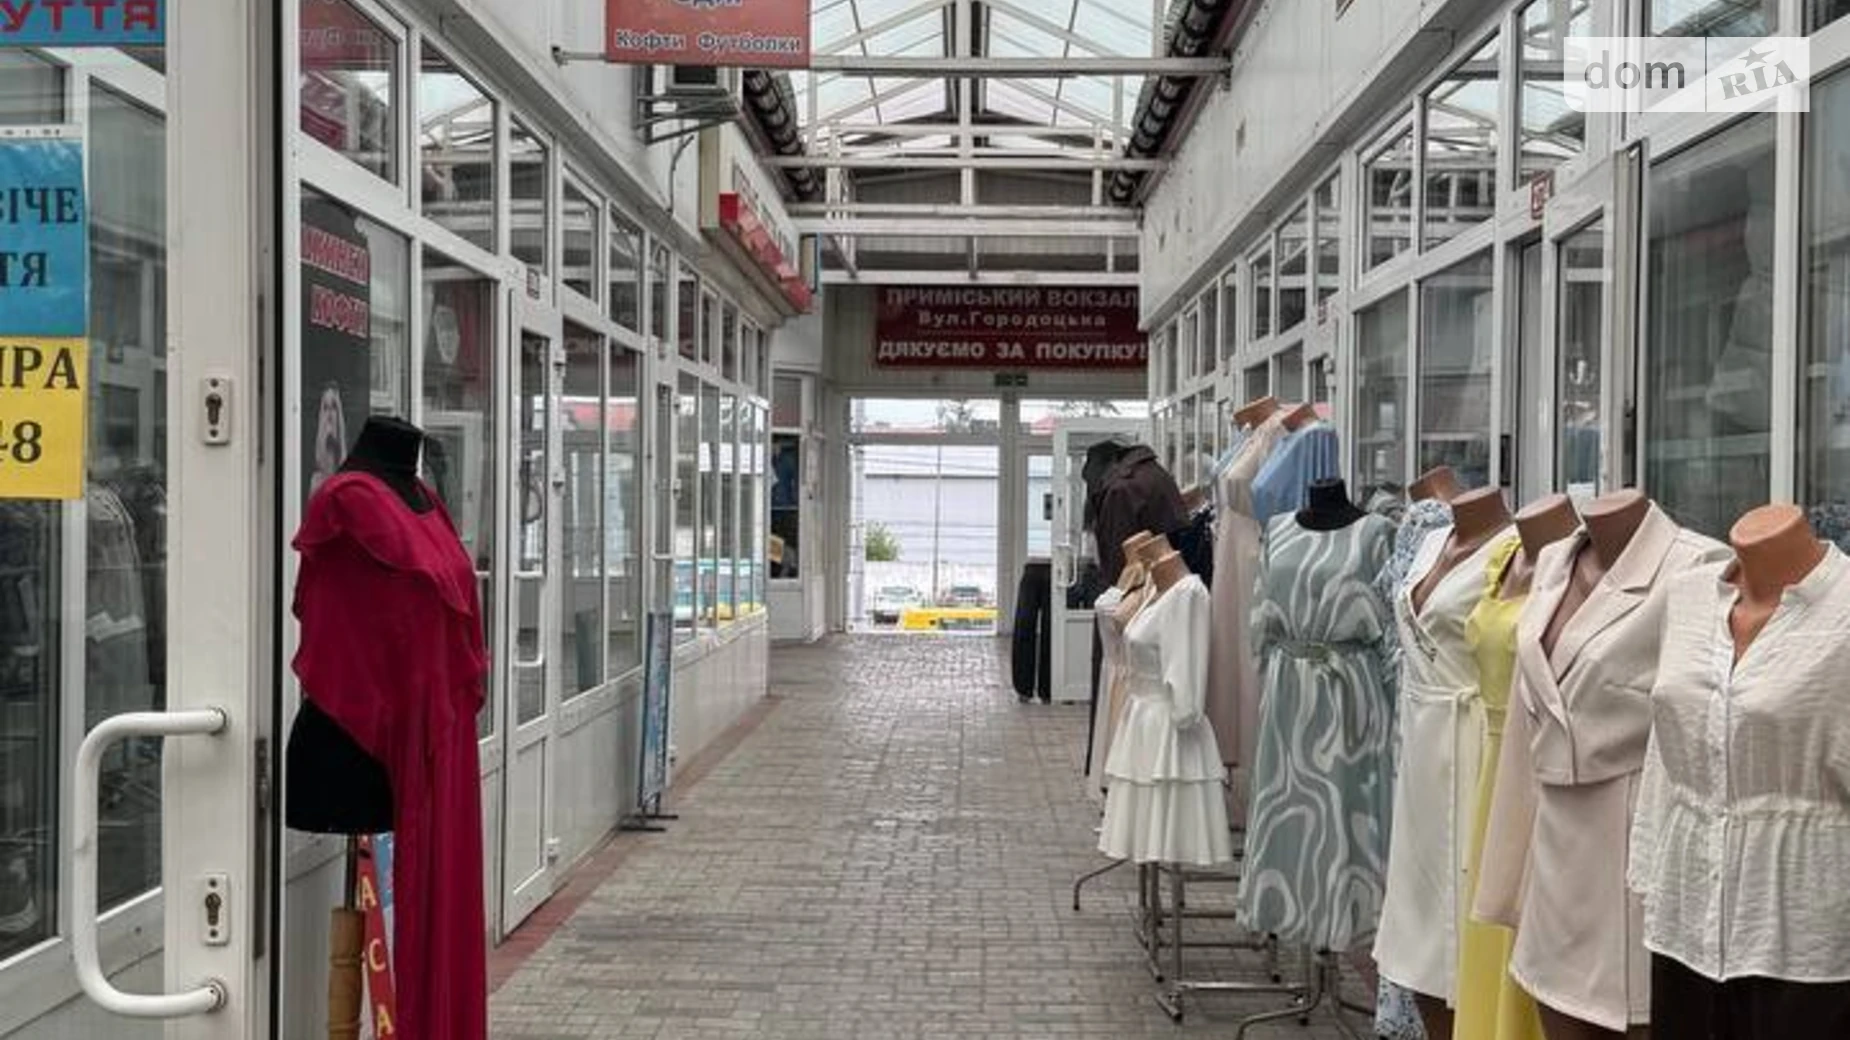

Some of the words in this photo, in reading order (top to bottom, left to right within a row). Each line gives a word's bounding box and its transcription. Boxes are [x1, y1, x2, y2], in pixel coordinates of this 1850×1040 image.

[616, 29, 686, 51] Кофти
[698, 31, 800, 54] Футболки
[0, 187, 79, 224] ІЧЕ
[885, 287, 1040, 307] ПРИМІСЬКИЙ
[1047, 289, 1138, 308] ВОКЗАЛ
[918, 310, 1107, 330] Вул.Городоцька
[878, 341, 985, 360] ДЯКУЄМО
[996, 341, 1026, 359] ЗА
[1036, 341, 1148, 360] ПОКУПКУ!
